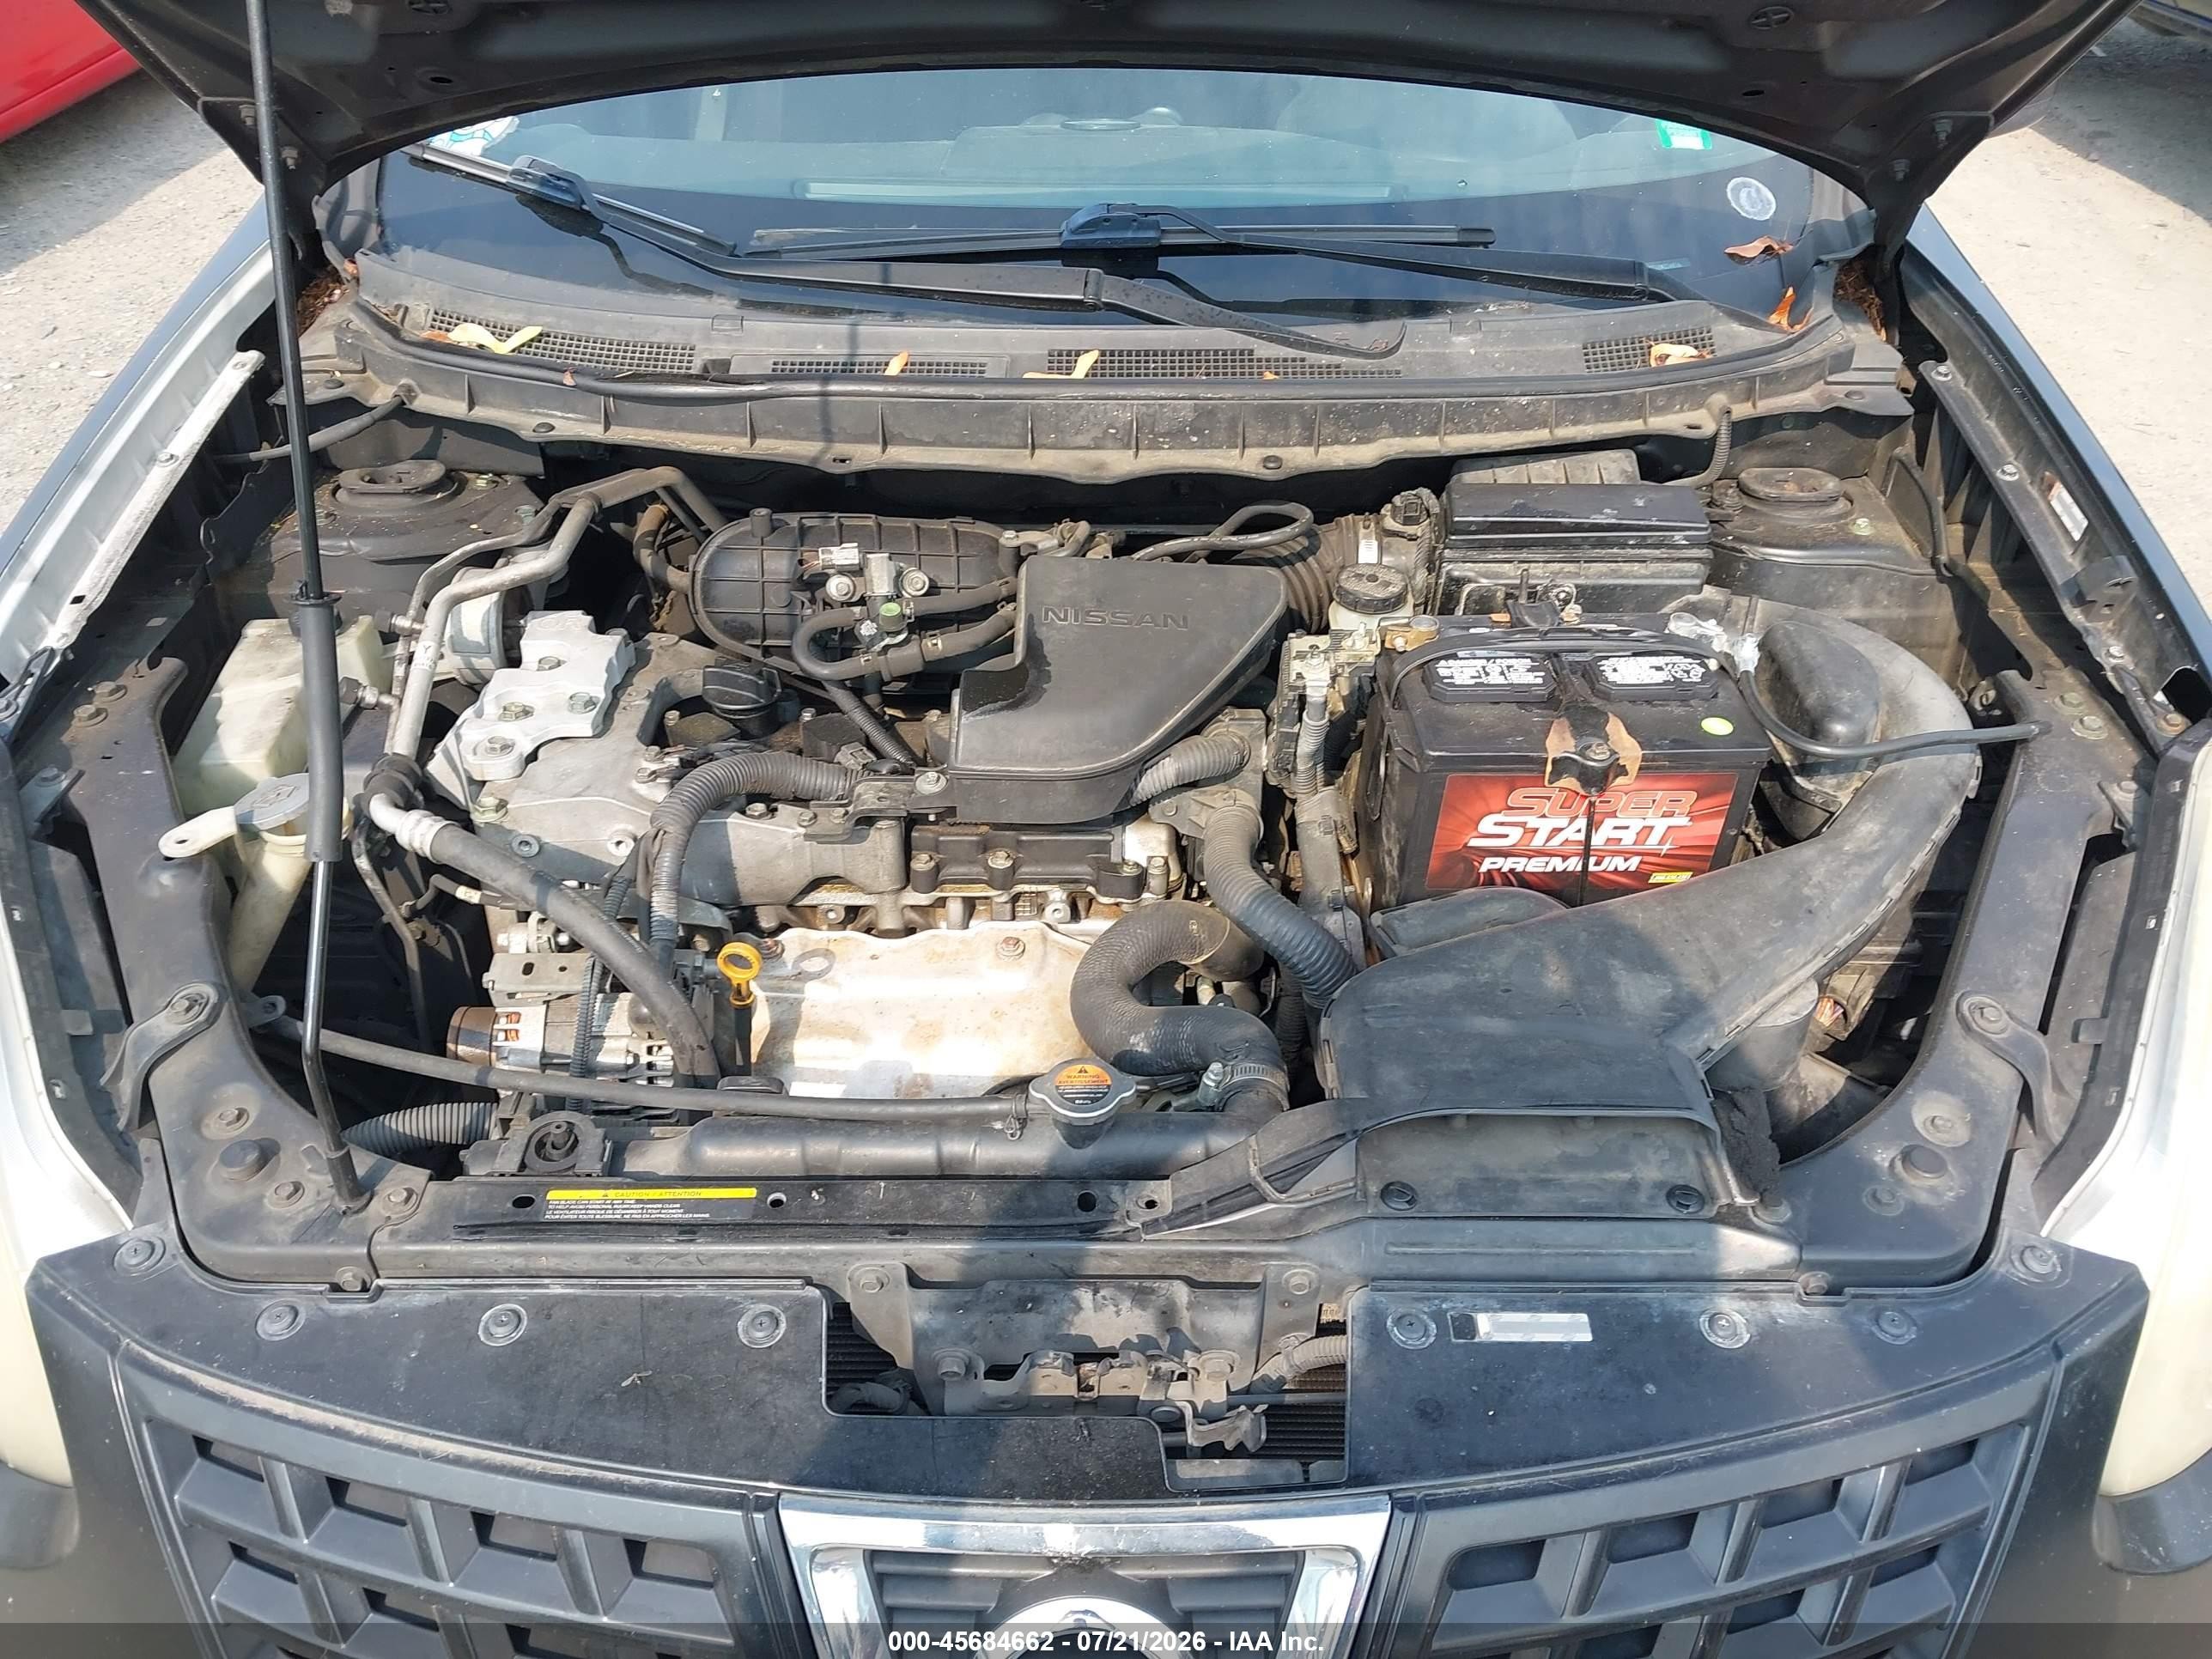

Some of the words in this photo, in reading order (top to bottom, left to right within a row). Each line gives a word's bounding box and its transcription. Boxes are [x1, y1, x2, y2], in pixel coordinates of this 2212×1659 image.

[1042, 605, 1190, 631] NISSAN
[1501, 787, 1698, 818] SUPER
[1467, 813, 1693, 848] START
[1478, 855, 1643, 873] PREMIUM
